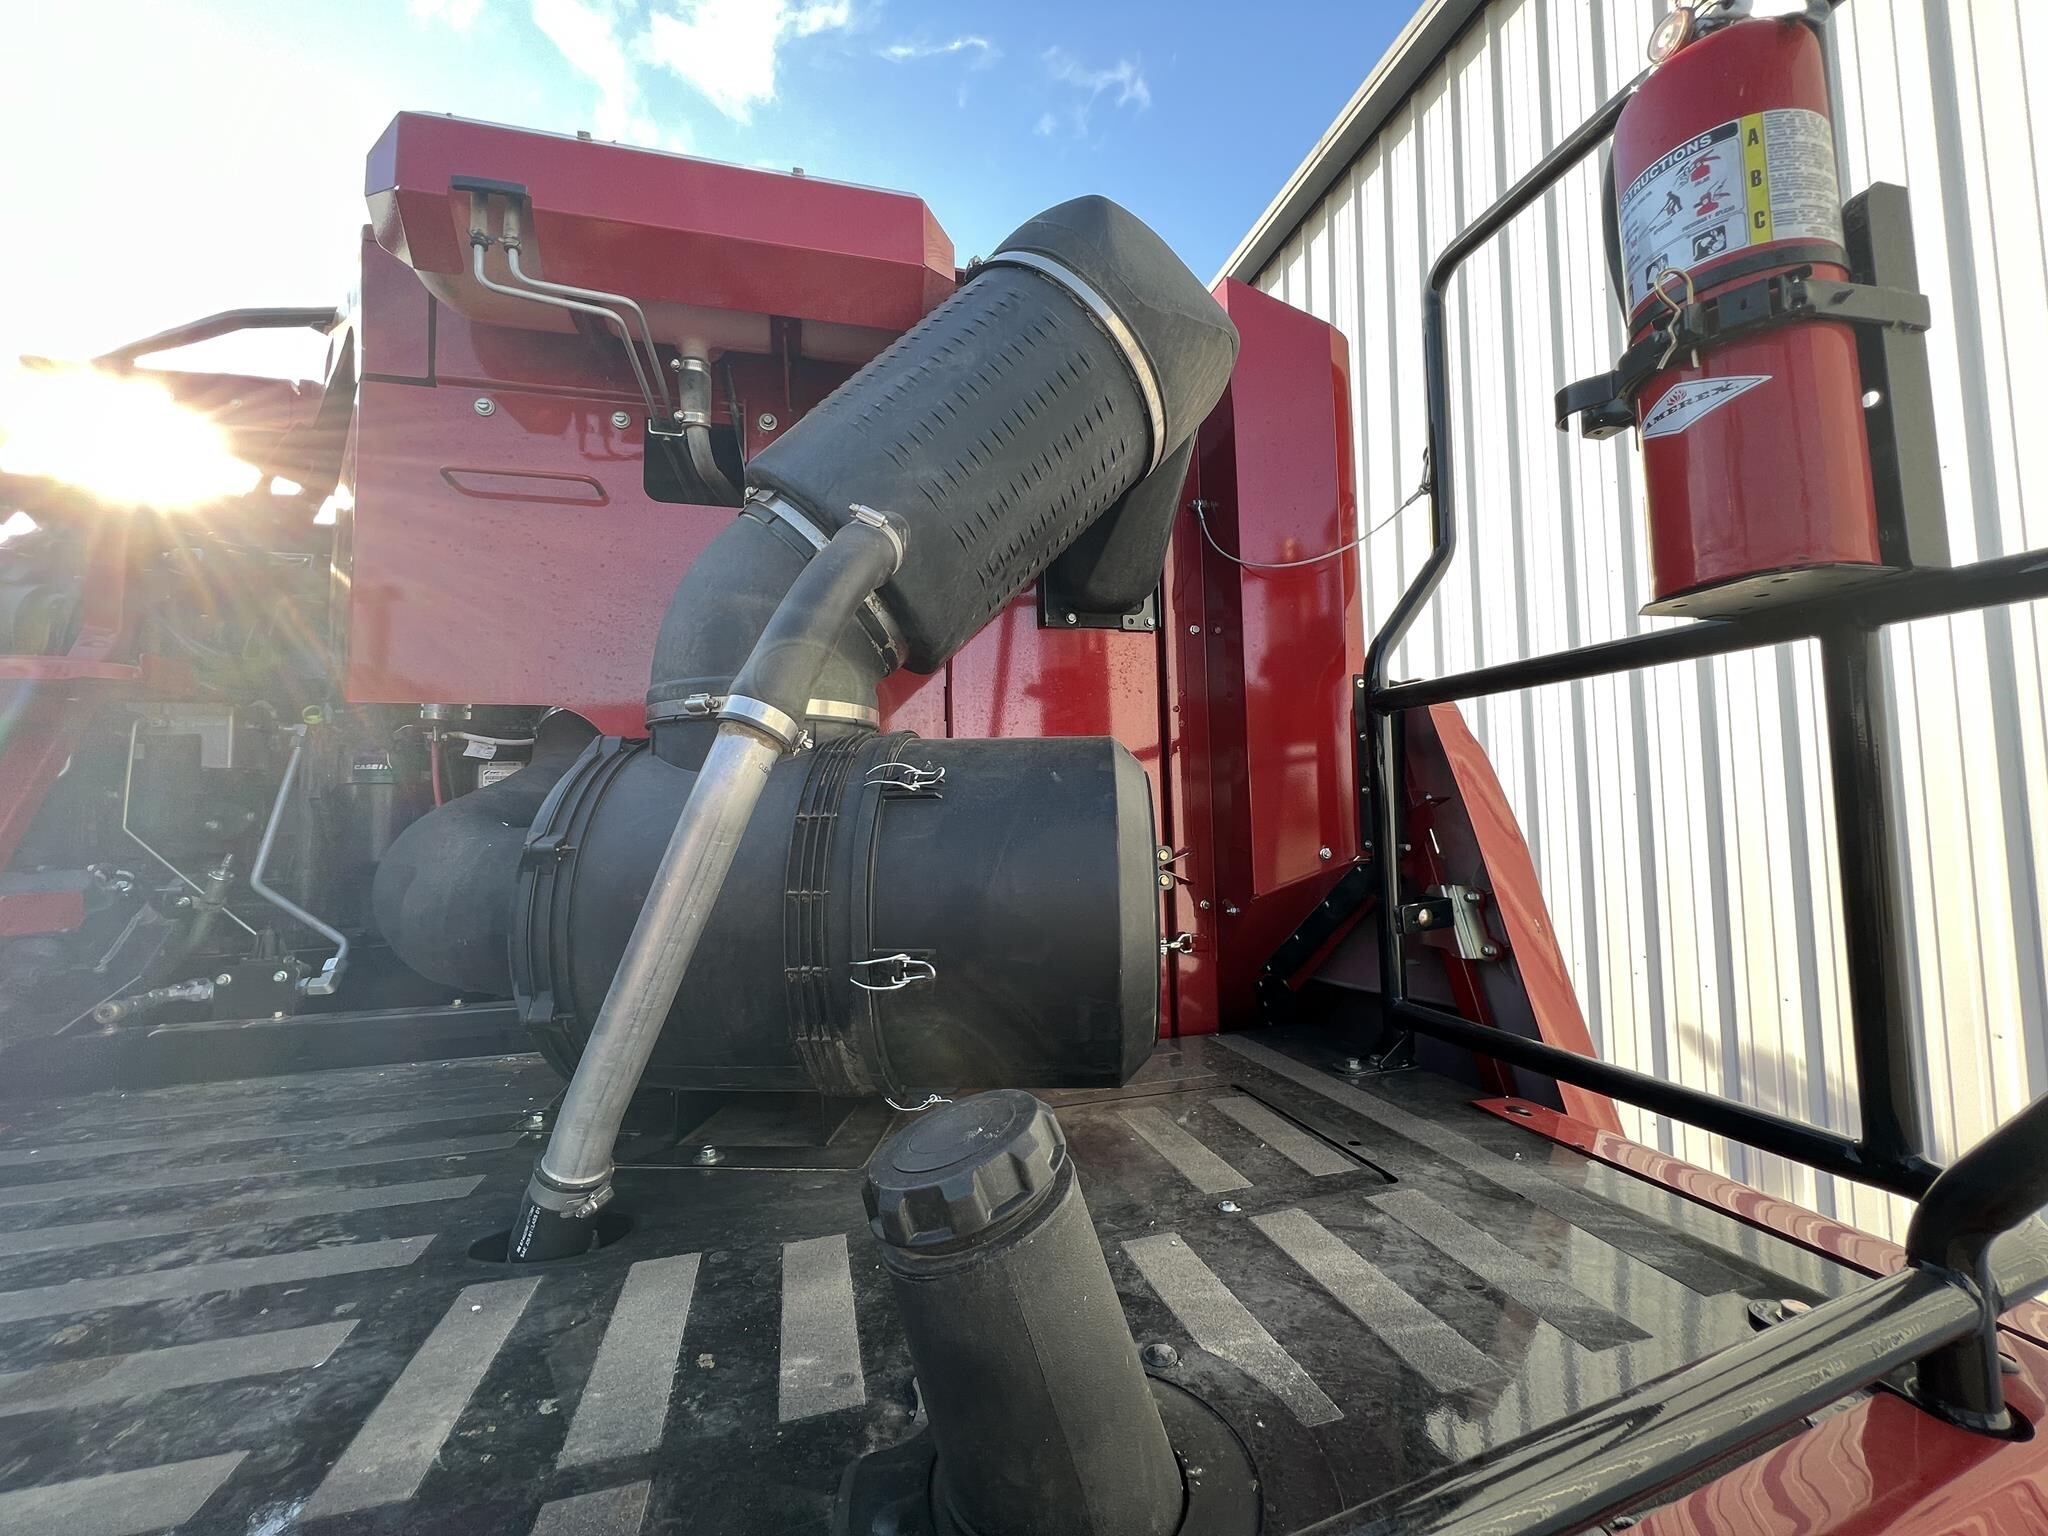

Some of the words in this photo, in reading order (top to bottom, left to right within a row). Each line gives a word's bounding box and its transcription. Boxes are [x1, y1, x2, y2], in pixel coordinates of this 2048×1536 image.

[1747, 128, 1759, 146] A
[1750, 169, 1762, 188] B
[1754, 211, 1765, 228] C
[1645, 382, 1735, 431] AMEREX
